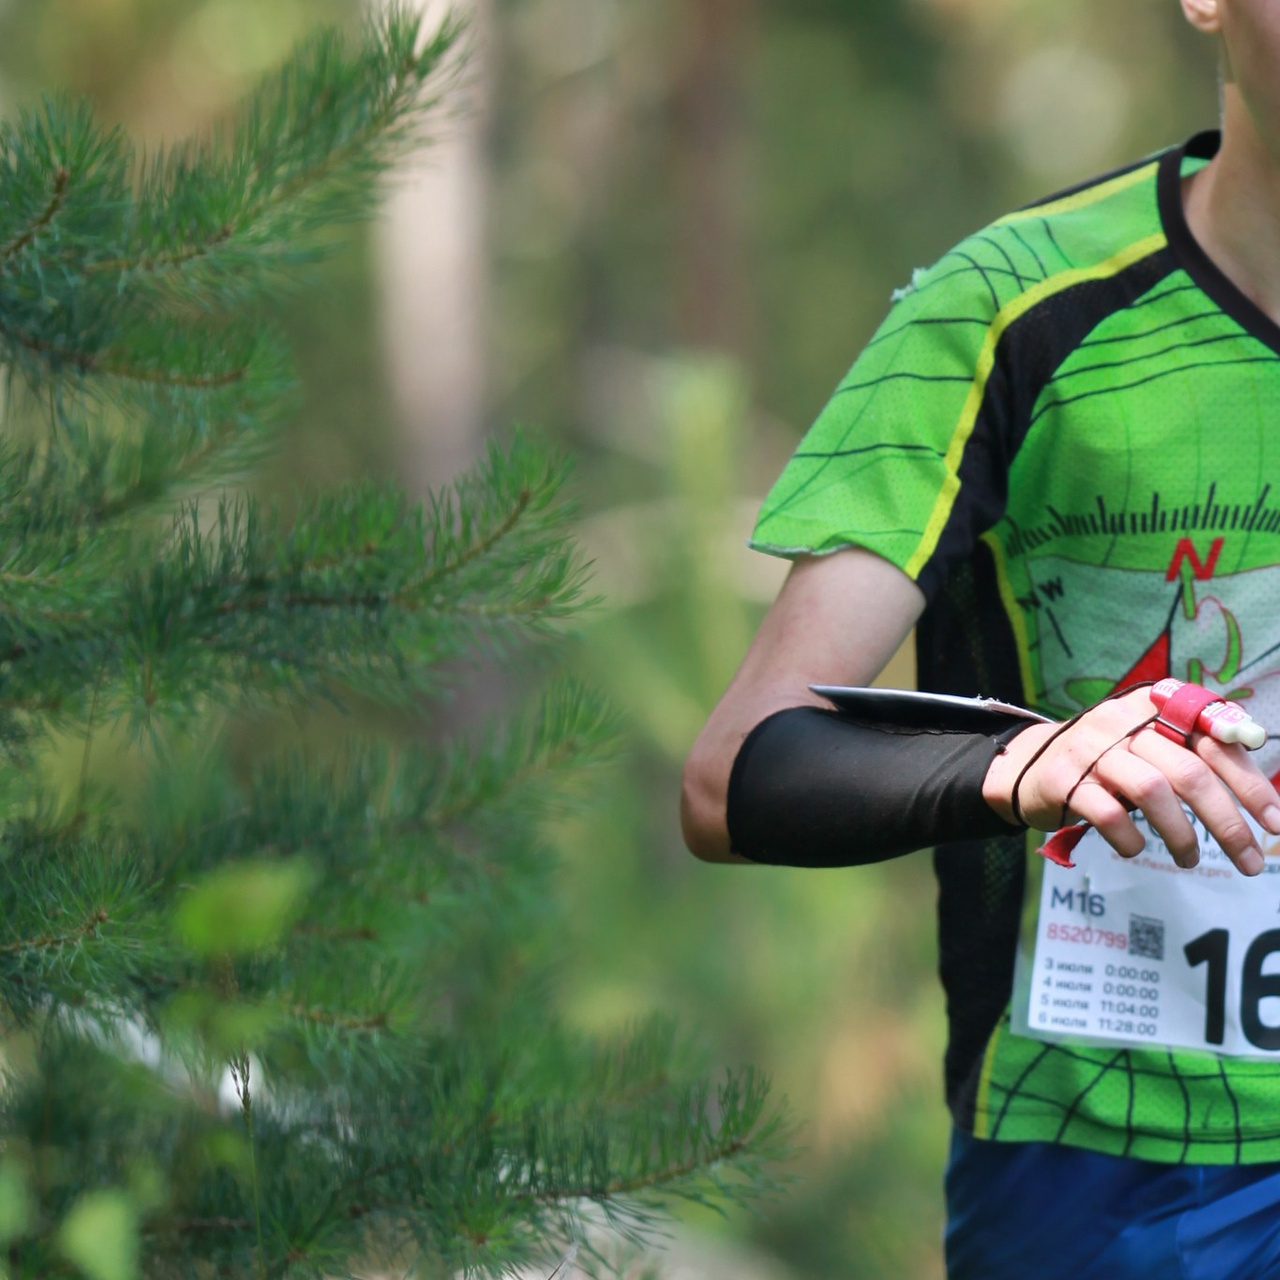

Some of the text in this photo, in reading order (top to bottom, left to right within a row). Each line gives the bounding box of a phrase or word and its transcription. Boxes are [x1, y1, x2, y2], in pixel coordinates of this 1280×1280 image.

[1165, 536, 1225, 582] N
[1105, 964, 1160, 984] 0:00:00
[1043, 976, 1052, 988] 4
[1103, 982, 1159, 1001] 0:00:00
[1101, 1000, 1159, 1019] 11:04:00
